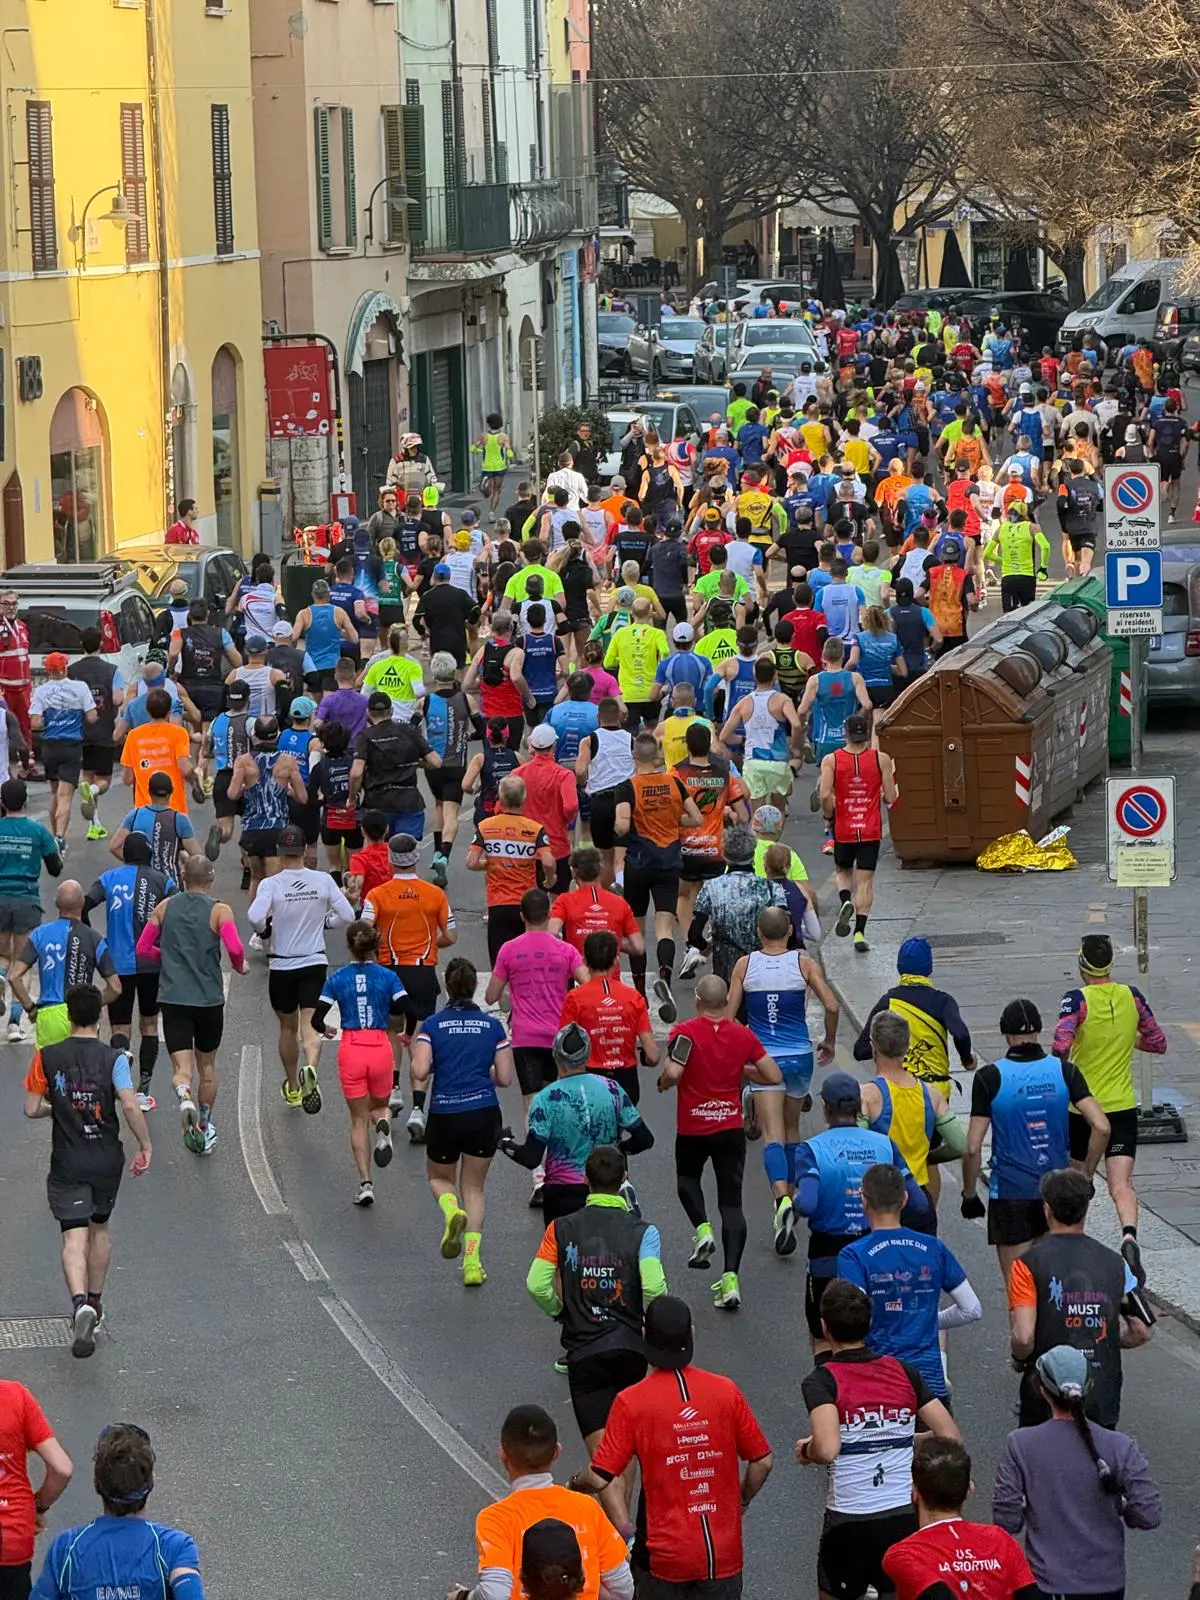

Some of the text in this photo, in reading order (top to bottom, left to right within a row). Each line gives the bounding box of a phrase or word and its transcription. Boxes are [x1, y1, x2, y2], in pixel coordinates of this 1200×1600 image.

[1119, 529, 1148, 537] sabato
[1117, 557, 1151, 602] P
[1125, 618, 1154, 626] residenti
[1120, 626, 1157, 634] autorizzati
[485, 843, 501, 854] GS
[137, 878, 148, 922] CAMISANO
[68, 936, 80, 986] CAMISANO
[355, 974, 367, 993] GS
[766, 994, 779, 1024] Beko
[890, 1239, 914, 1247] ATHLETIC
[914, 1241, 928, 1253] CLUB
[583, 1267, 615, 1277] MUST
[580, 1278, 617, 1289] GO ON
[1068, 1304, 1101, 1316] MUST
[1065, 1317, 1103, 1328] GO ON
[955, 1548, 977, 1560] U.S.
[938, 1558, 1002, 1572] LA SPORTIVA
